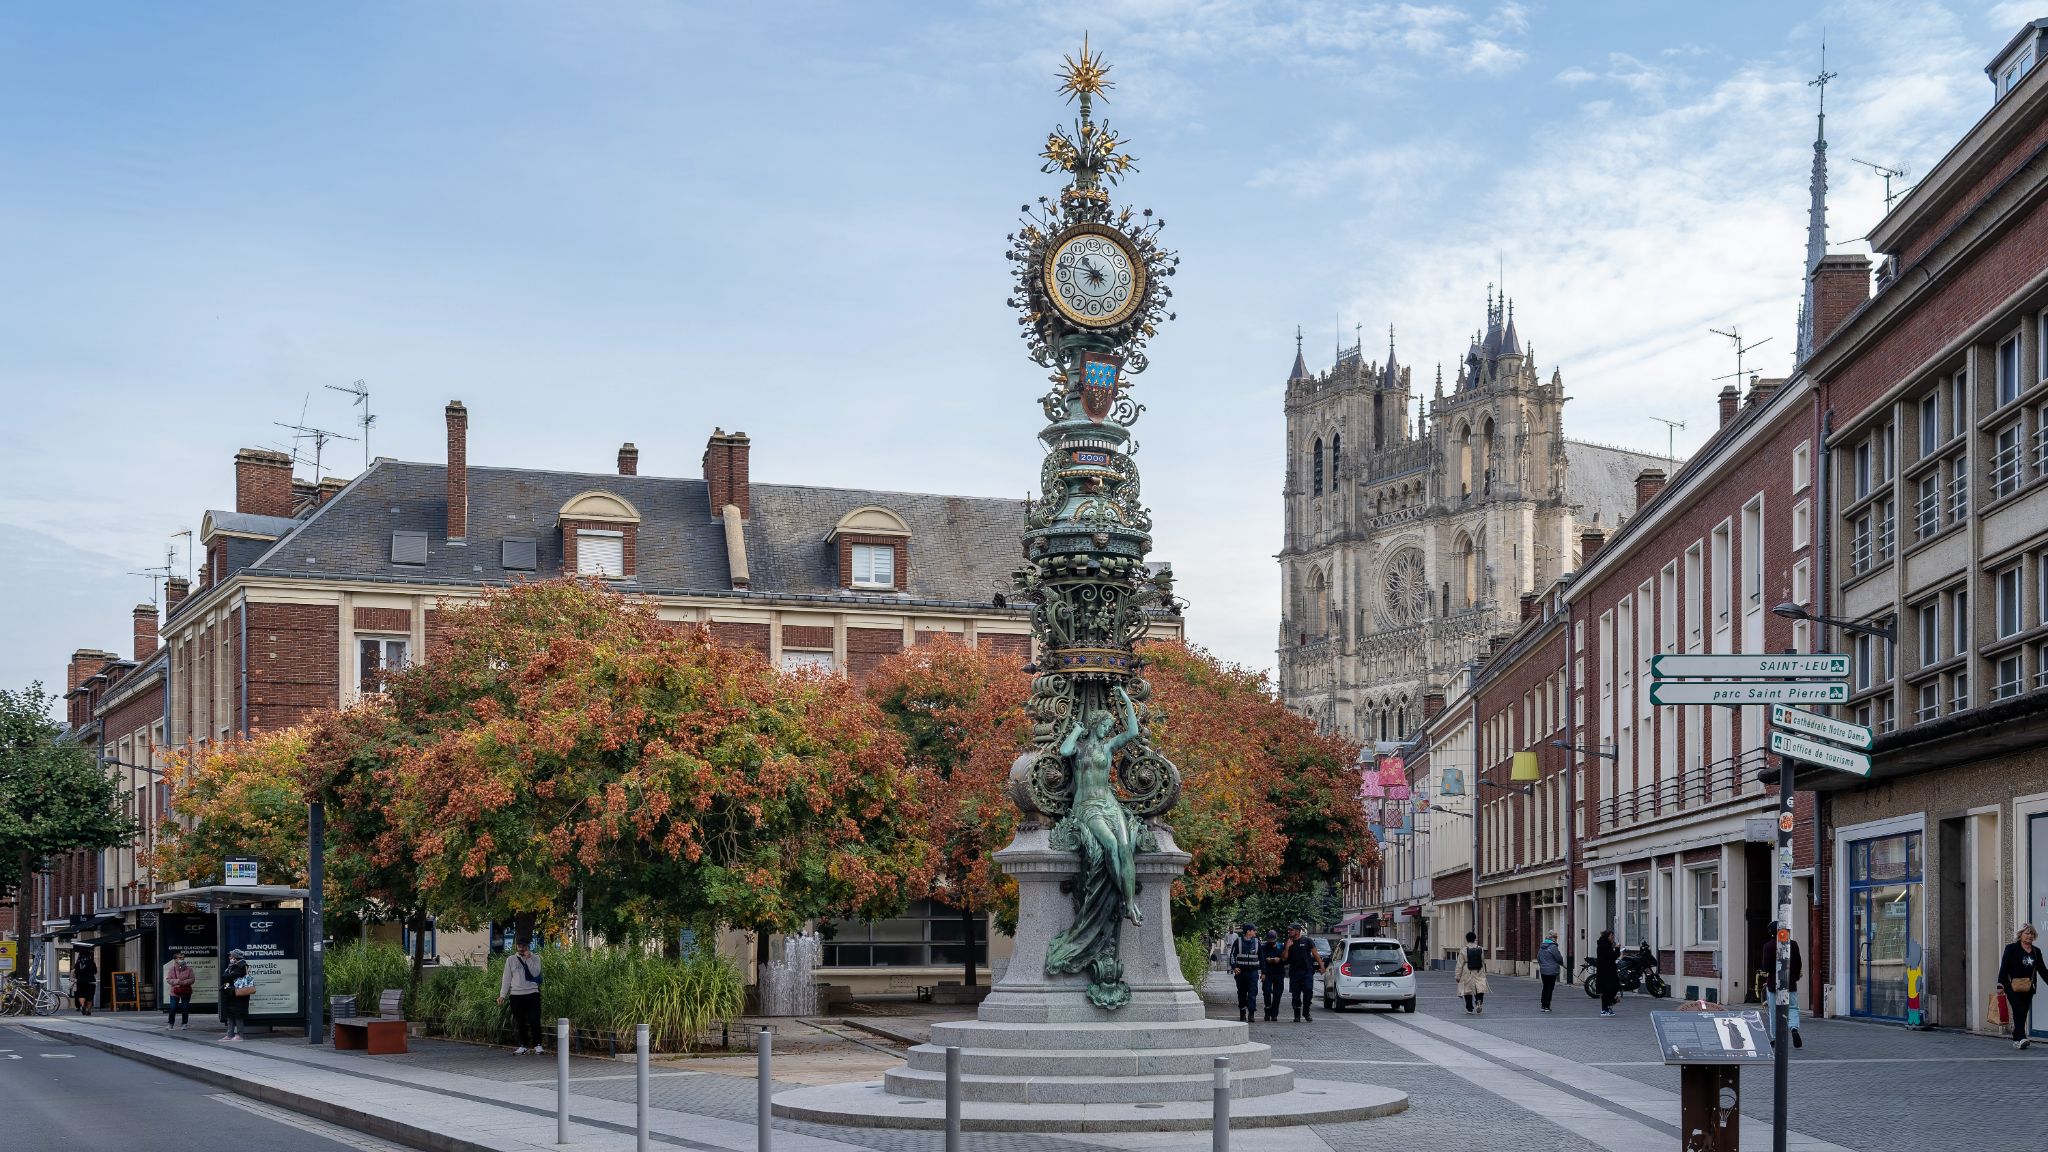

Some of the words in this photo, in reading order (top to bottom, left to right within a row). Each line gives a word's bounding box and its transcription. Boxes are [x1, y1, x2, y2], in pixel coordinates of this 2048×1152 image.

[1060, 270, 1066, 278] 9
[1064, 286, 1071, 294] 8
[1076, 298, 1082, 306] 7
[1106, 300, 1112, 308] 5
[1091, 303, 1097, 311] 6
[1081, 454, 1104, 462] 2000
[1759, 661, 1829, 671] SAINT-LEU
[1713, 690, 1741, 700] parc
[1748, 688, 1782, 698] Saint
[1788, 688, 1827, 698] Pierre
[1793, 716, 1827, 732] cathédrale
[1828, 724, 1846, 737] Notre
[1847, 729, 1865, 742] Dame
[1792, 742, 1812, 756] office
[1814, 749, 1823, 758] de
[1826, 752, 1854, 767] tourisme
[249, 921, 274, 929] CCF
[247, 968, 282, 976] énération
